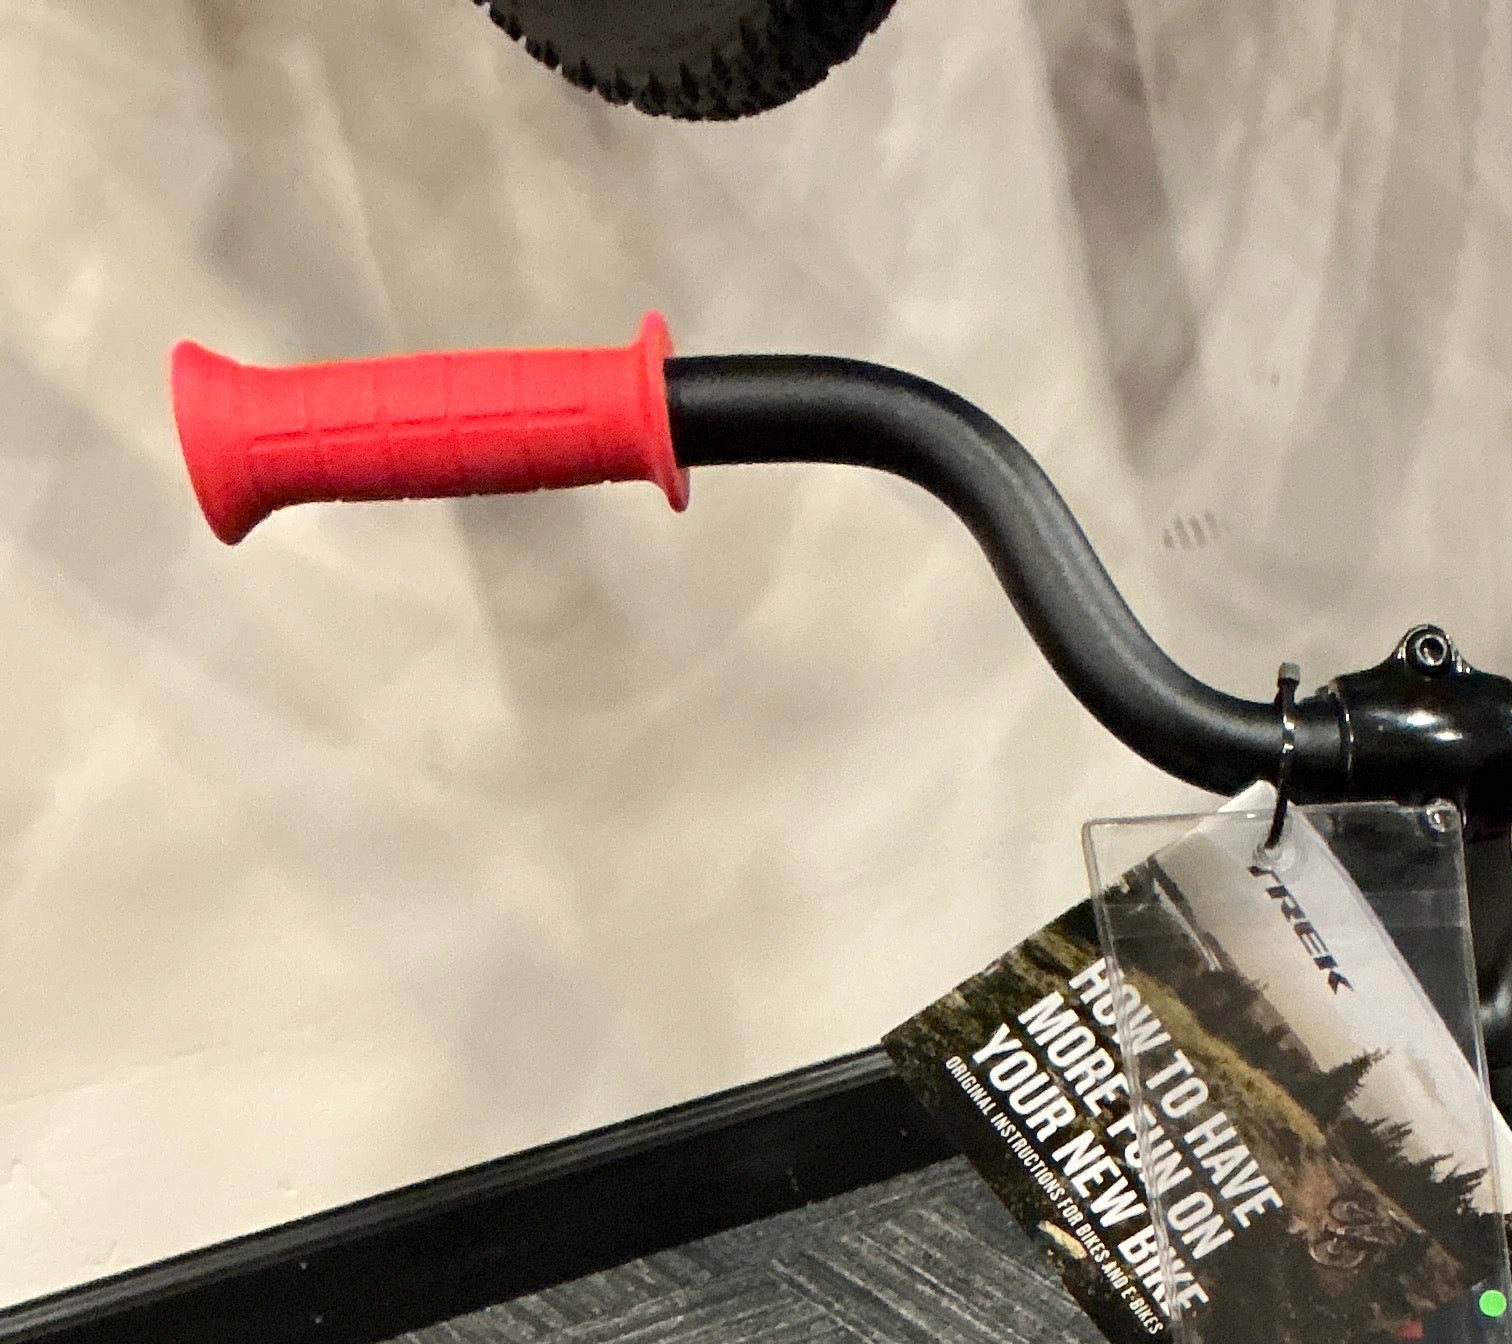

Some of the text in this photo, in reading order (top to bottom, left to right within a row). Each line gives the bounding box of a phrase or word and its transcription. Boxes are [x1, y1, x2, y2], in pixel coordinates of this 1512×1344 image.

[1247, 865, 1355, 995] TREK
[945, 1055, 1164, 1335] ORIGINAL INSTRUCTIONS FOR BIKES AND E-BIKES
[972, 1022, 1210, 1317] YOUR NEW BIKE
[1017, 990, 1235, 1260] MORE FUN ON
[1068, 957, 1284, 1229] HOW TO HAVE
